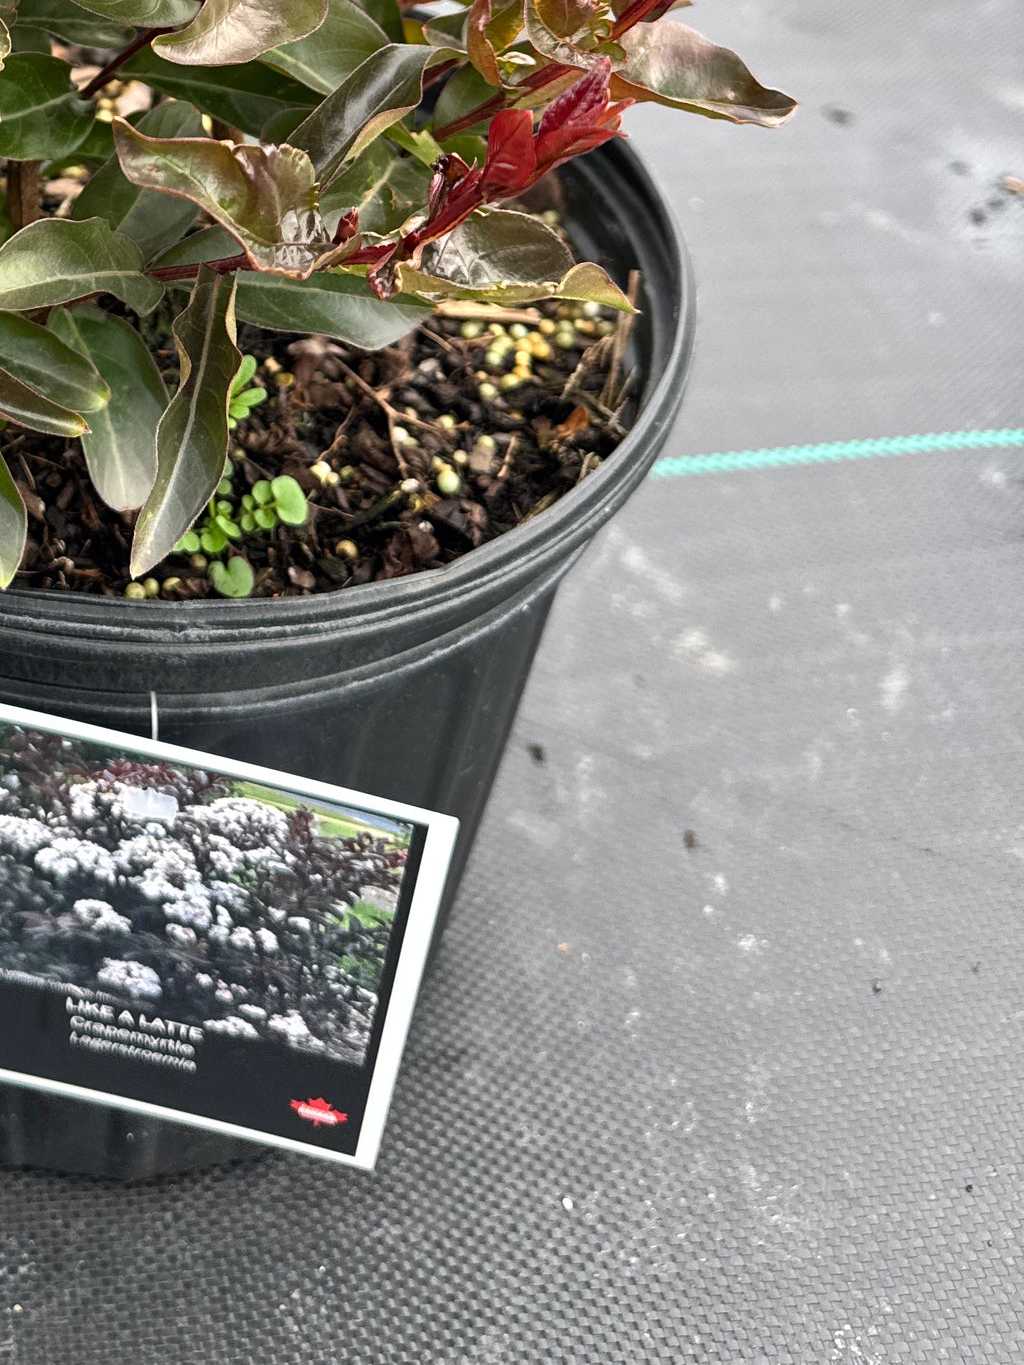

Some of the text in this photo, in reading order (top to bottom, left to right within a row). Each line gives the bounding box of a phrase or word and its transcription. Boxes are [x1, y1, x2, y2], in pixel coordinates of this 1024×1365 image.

[65, 996, 205, 1043] LIKE A LATTE
